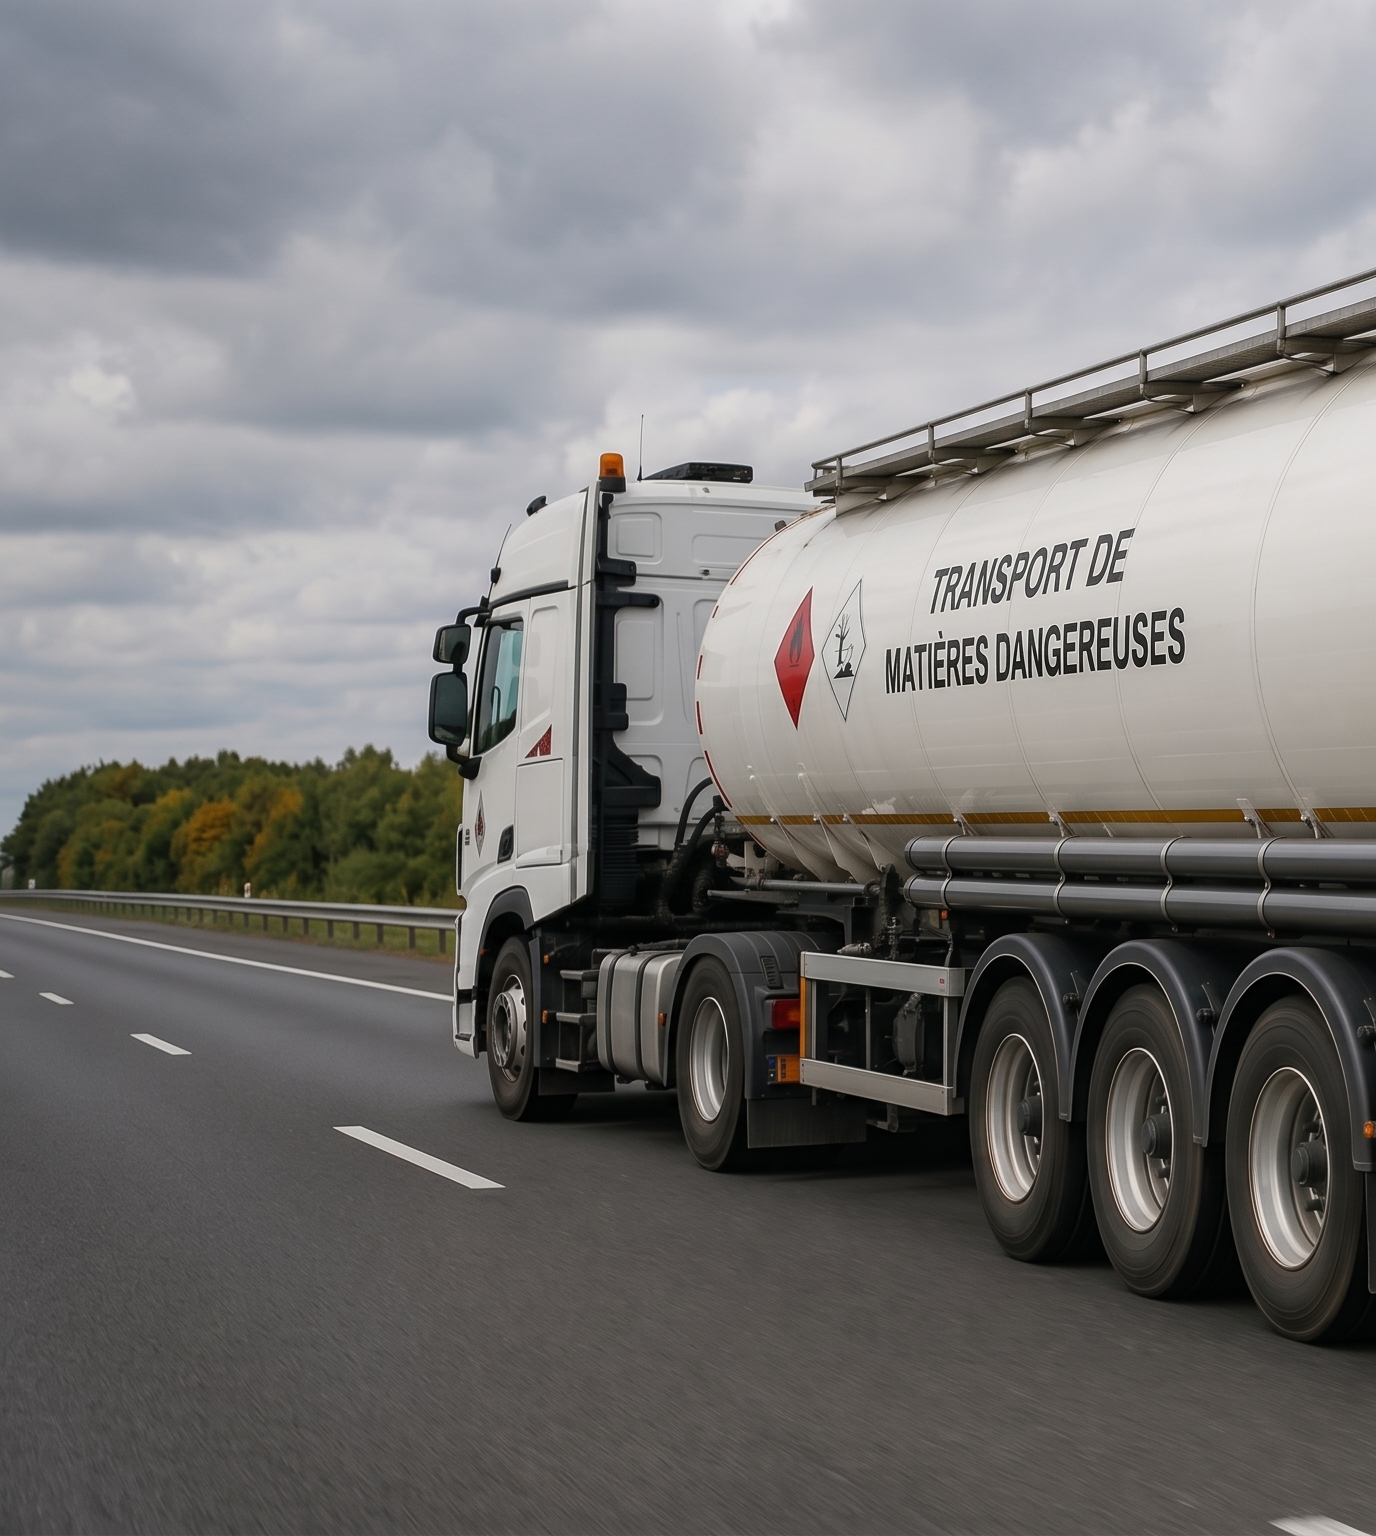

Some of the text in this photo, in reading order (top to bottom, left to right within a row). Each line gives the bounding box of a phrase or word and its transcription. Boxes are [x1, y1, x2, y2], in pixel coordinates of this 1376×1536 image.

[930, 527, 1136, 615] TRANSPORT DE
[885, 607, 1186, 694] MATIÈRES DANGEREUSES
